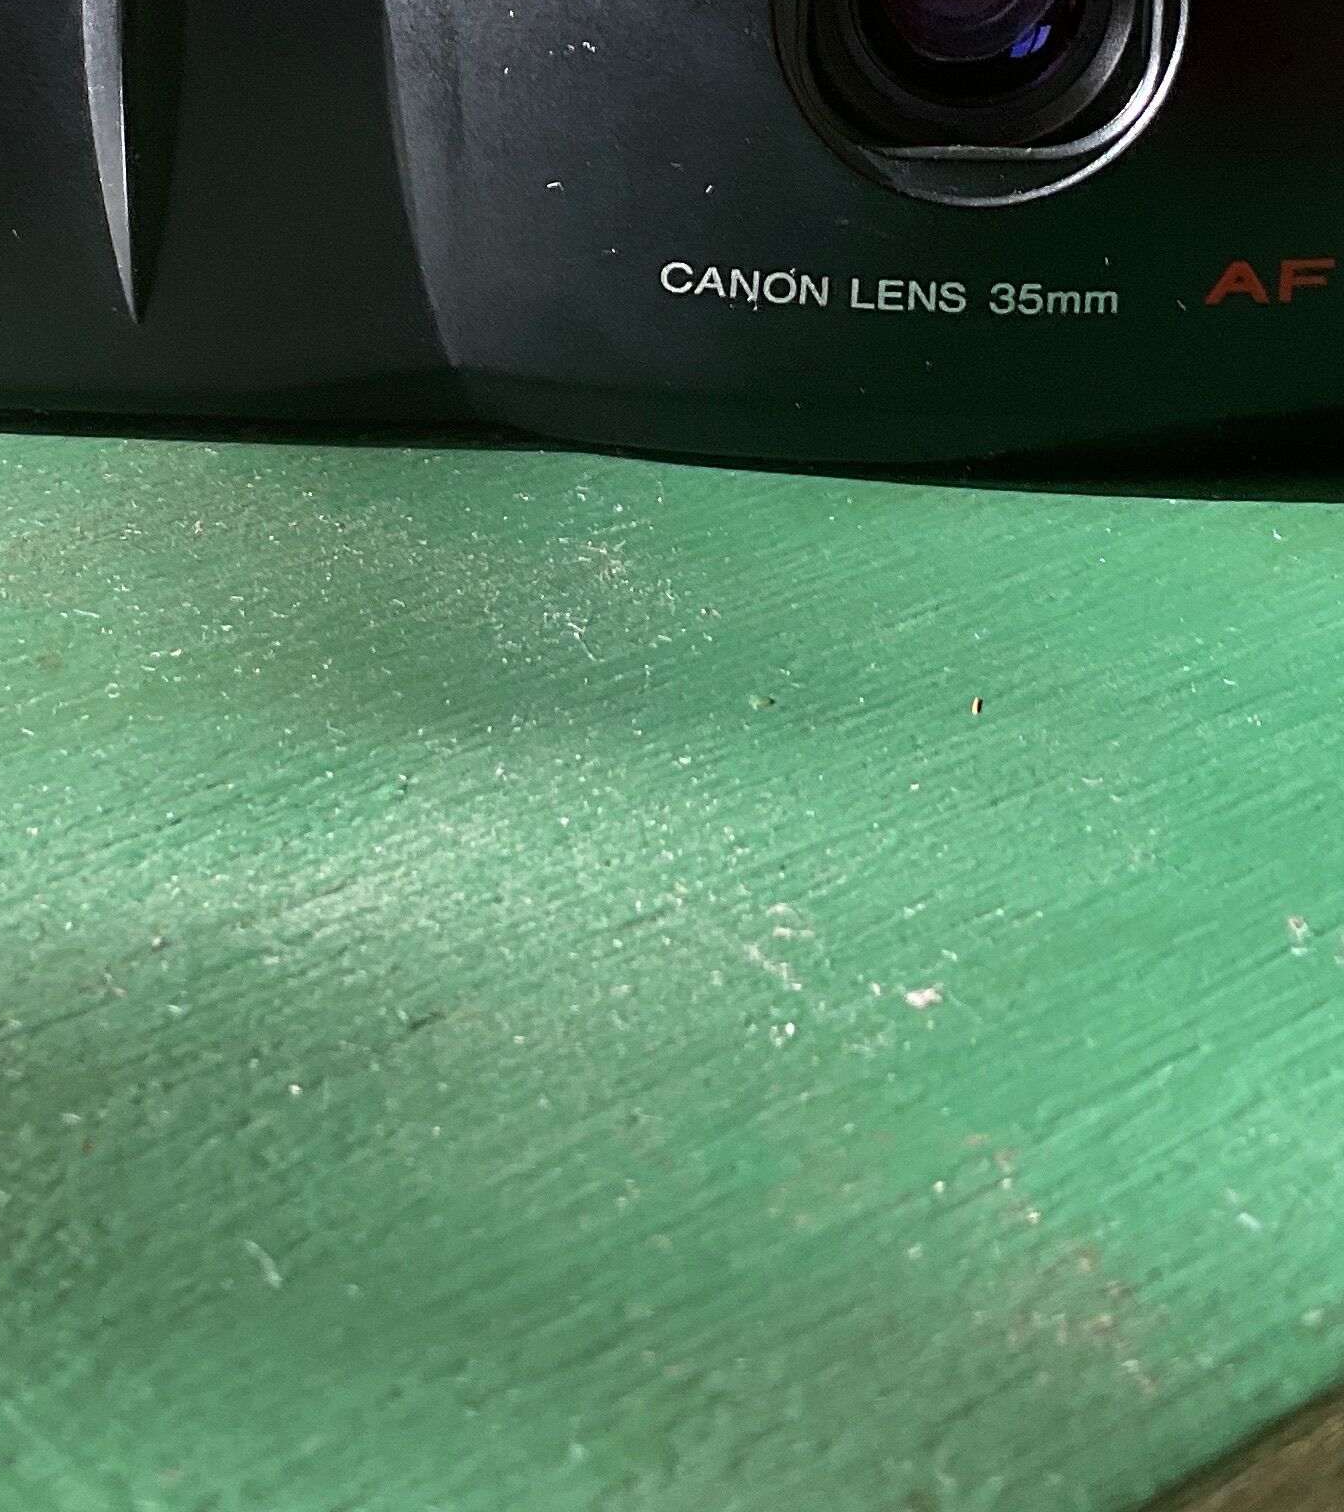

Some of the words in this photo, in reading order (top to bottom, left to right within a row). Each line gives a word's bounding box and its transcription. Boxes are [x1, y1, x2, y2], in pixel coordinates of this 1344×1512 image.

[659, 260, 829, 308] CANON
[850, 277, 967, 312] LENS
[989, 282, 1119, 316] 35mm
[1204, 258, 1336, 306] AF
